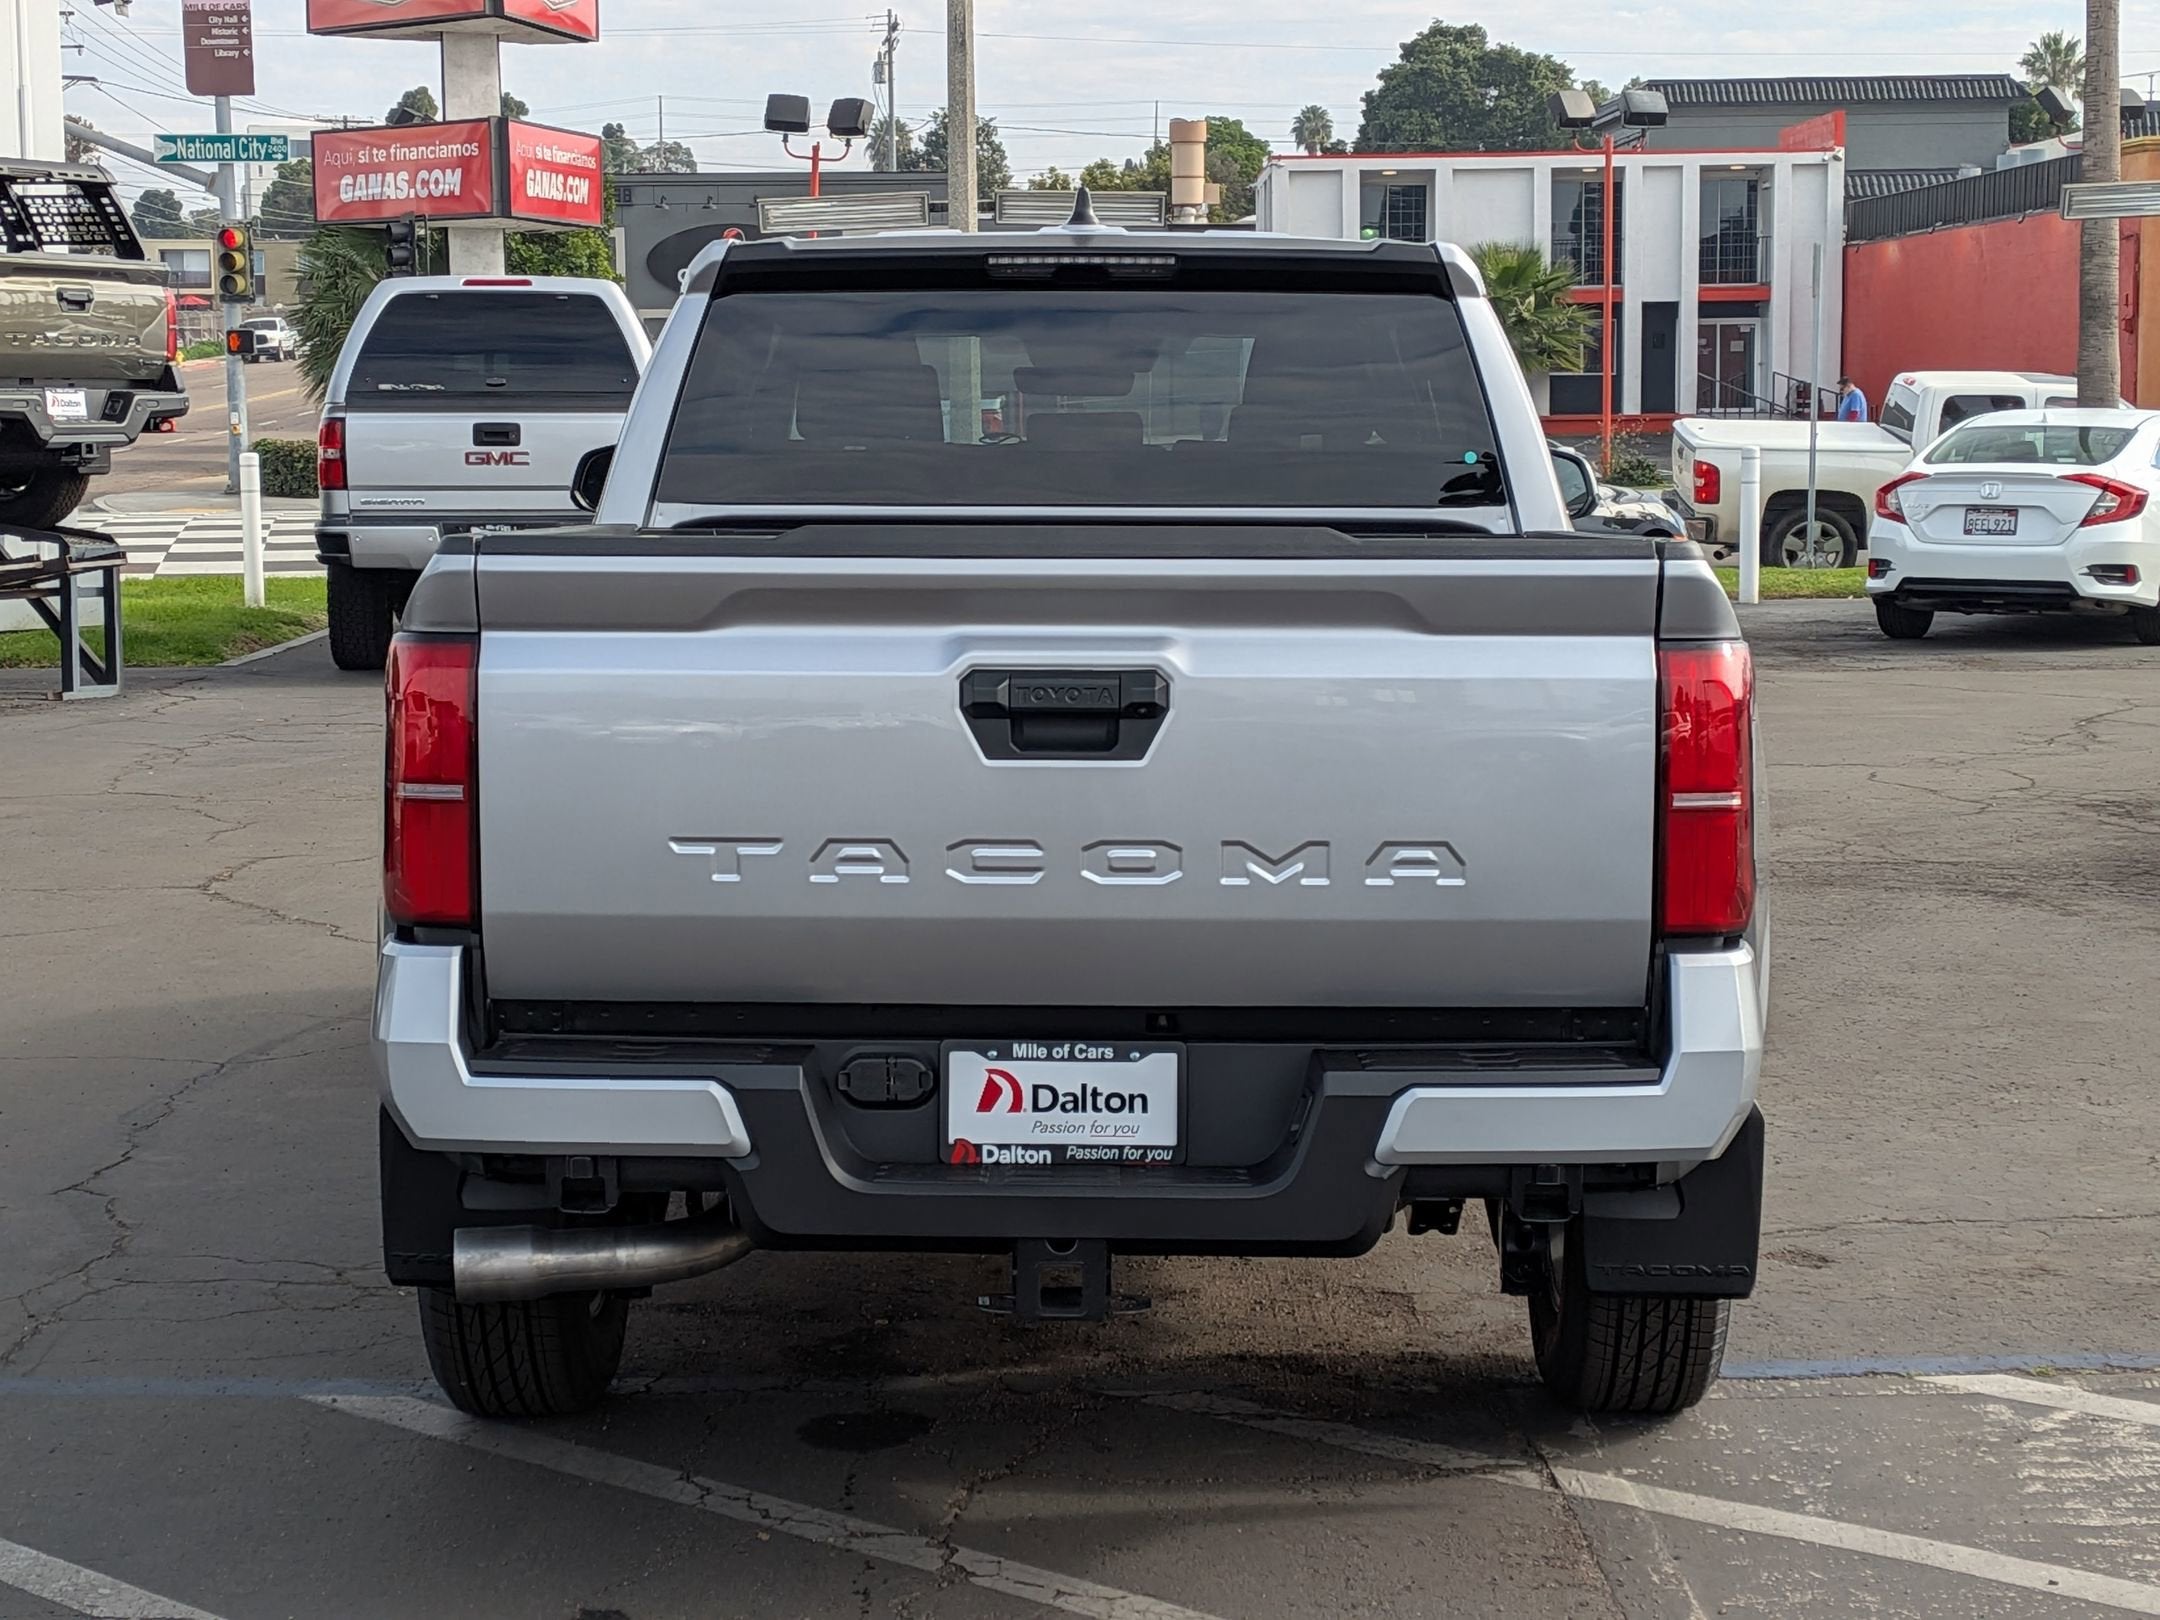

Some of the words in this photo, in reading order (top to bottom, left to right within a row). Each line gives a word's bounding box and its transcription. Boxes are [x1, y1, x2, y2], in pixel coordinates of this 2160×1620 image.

[208, 3, 221, 11] OF
[222, 3, 248, 11] CARS
[208, 15, 222, 25] City
[223, 15, 239, 24] Hall
[211, 27, 240, 35] Historic
[214, 49, 240, 59] Library
[176, 137, 236, 160] National
[238, 137, 267, 160] City
[372, 147, 387, 163] te
[389, 140, 479, 161] financiamos
[339, 167, 463, 203] GANAS.COM
[526, 168, 590, 205] GANAS.COM
[5, 331, 142, 349] TACOMA
[465, 451, 530, 466] GMC
[1015, 686, 1114, 704] TOYOTA
[667, 836, 1467, 885] TACOMA
[1012, 1042, 1048, 1060] Mile
[1051, 1042, 1071, 1060] of
[1073, 1043, 1115, 1060] Cars
[1031, 1082, 1149, 1115] Dalton
[1031, 1120, 1086, 1135] Passion
[1089, 1119, 1110, 1136] for
[1112, 1123, 1140, 1136] you
[982, 1144, 1053, 1164] Dalton
[1066, 1146, 1120, 1161] Passion
[1122, 1147, 1143, 1163] for
[1144, 1149, 1173, 1163] you
